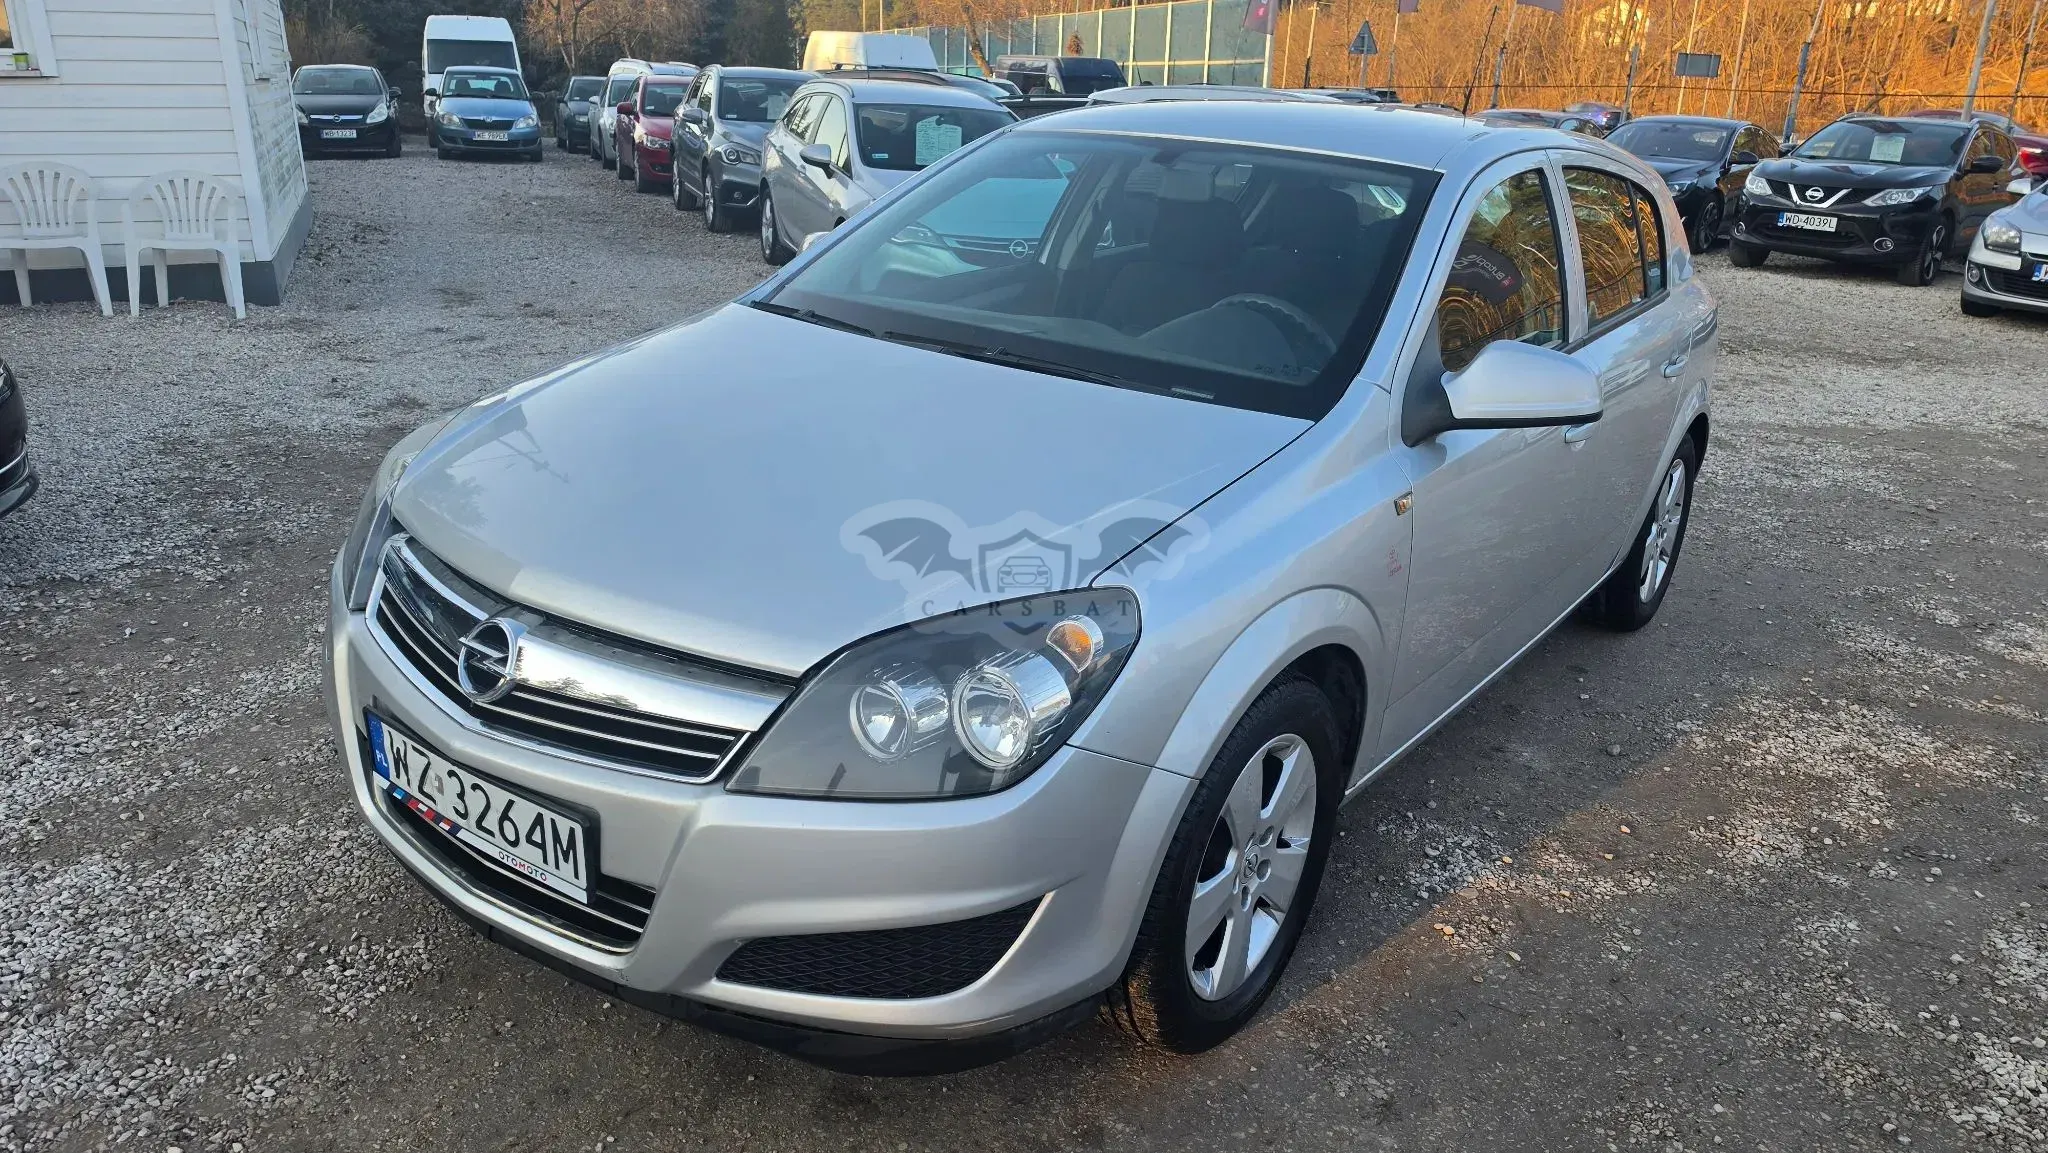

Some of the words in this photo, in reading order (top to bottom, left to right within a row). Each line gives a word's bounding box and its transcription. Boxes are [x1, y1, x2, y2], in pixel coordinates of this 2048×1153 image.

[1785, 214, 1800, 225] WD
[1803, 216, 1835, 229] 4039L
[375, 749, 388, 769] PL
[387, 729, 437, 806] WZ
[446, 768, 580, 881] 3264M
[498, 851, 548, 882] OTOMOTO
